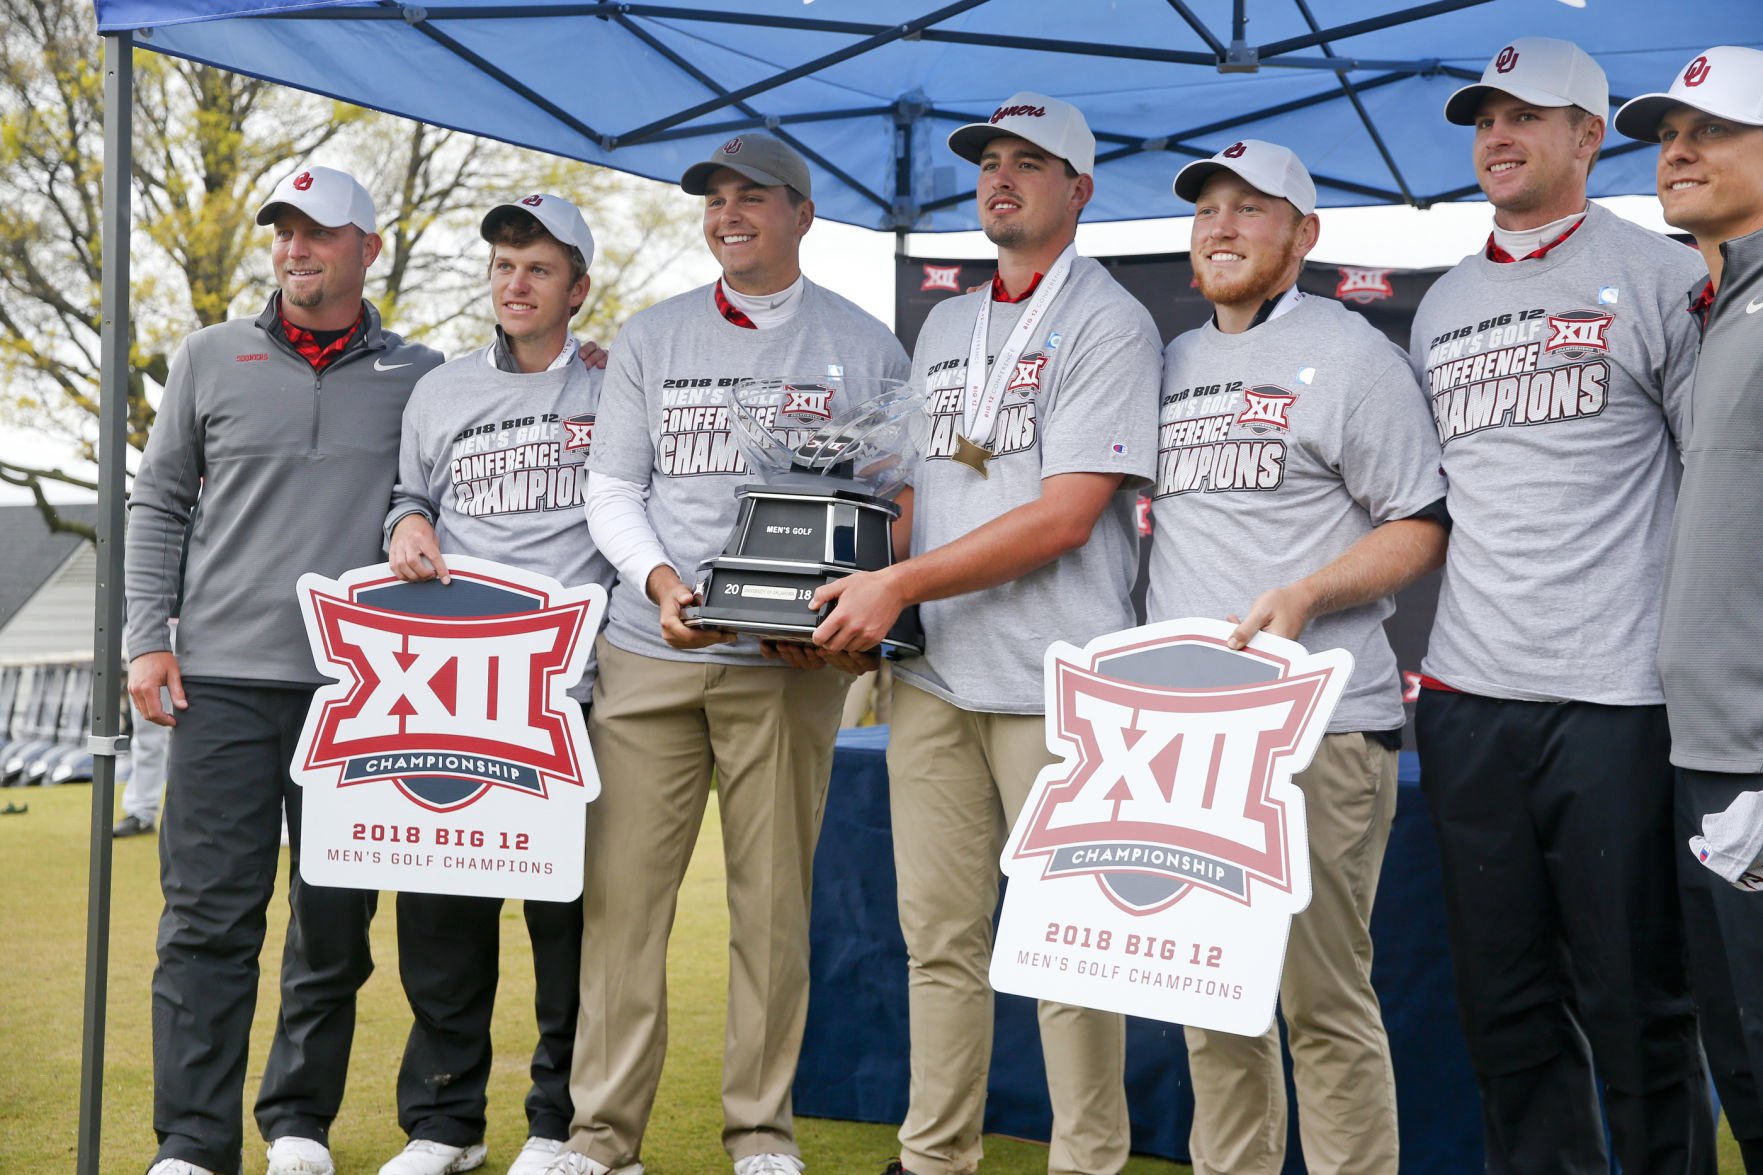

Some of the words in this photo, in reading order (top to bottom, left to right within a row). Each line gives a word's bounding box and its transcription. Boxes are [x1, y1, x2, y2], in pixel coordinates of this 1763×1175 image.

[1495, 46, 1519, 74] OU
[1683, 55, 1711, 87] OU
[722, 137, 743, 154] OU
[1222, 142, 1247, 158] OU
[293, 171, 314, 191] OU
[521, 194, 543, 207] OU
[925, 266, 958, 289] XII
[1340, 269, 1388, 291] XII
[1430, 325, 1474, 350] 2018
[1477, 313, 1513, 333] BIG
[1518, 308, 1546, 321] 12
[1551, 320, 1608, 345] XII
[1425, 333, 1484, 370] MEN'S
[1488, 320, 1543, 349] GOLF
[927, 359, 960, 376] 2018
[663, 378, 713, 389] 2018
[1163, 388, 1190, 406] 2018
[1193, 384, 1221, 397] BIG
[1225, 381, 1243, 393] 12
[662, 389, 725, 406] MEN'S
[783, 391, 831, 416] XII
[1200, 393, 1241, 416] GOLF
[1240, 395, 1296, 425] XII
[453, 423, 496, 443] 2018
[501, 416, 535, 431] BIG
[540, 413, 559, 423] 12
[452, 431, 509, 460] MEN'S
[516, 423, 560, 445] GOLF
[450, 442, 561, 487] CONFERENCE
[453, 464, 592, 518] CHAMPION
[766, 525, 791, 534] MEN'S
[792, 527, 813, 535] GOLF
[724, 583, 740, 594] 20
[798, 589, 812, 600] 18
[332, 618, 561, 757] XII
[365, 755, 521, 781] CHAMPIONSHIP
[1044, 689, 1297, 856] XII
[352, 823, 421, 844] 2018
[435, 827, 485, 848] BIG
[499, 831, 530, 851] 12
[327, 848, 381, 864] MEN'S
[391, 852, 434, 867] GOLF
[443, 856, 554, 875] CHAMPIONS
[1071, 848, 1226, 881] CHAMPIONSHIP
[1045, 922, 1113, 951] 2018
[1125, 933, 1177, 961] BIG
[1188, 943, 1224, 969] 12
[1016, 949, 1070, 971] MEN'S
[1077, 959, 1122, 980] GOLF
[1128, 967, 1245, 1001] CHAMPIONS
